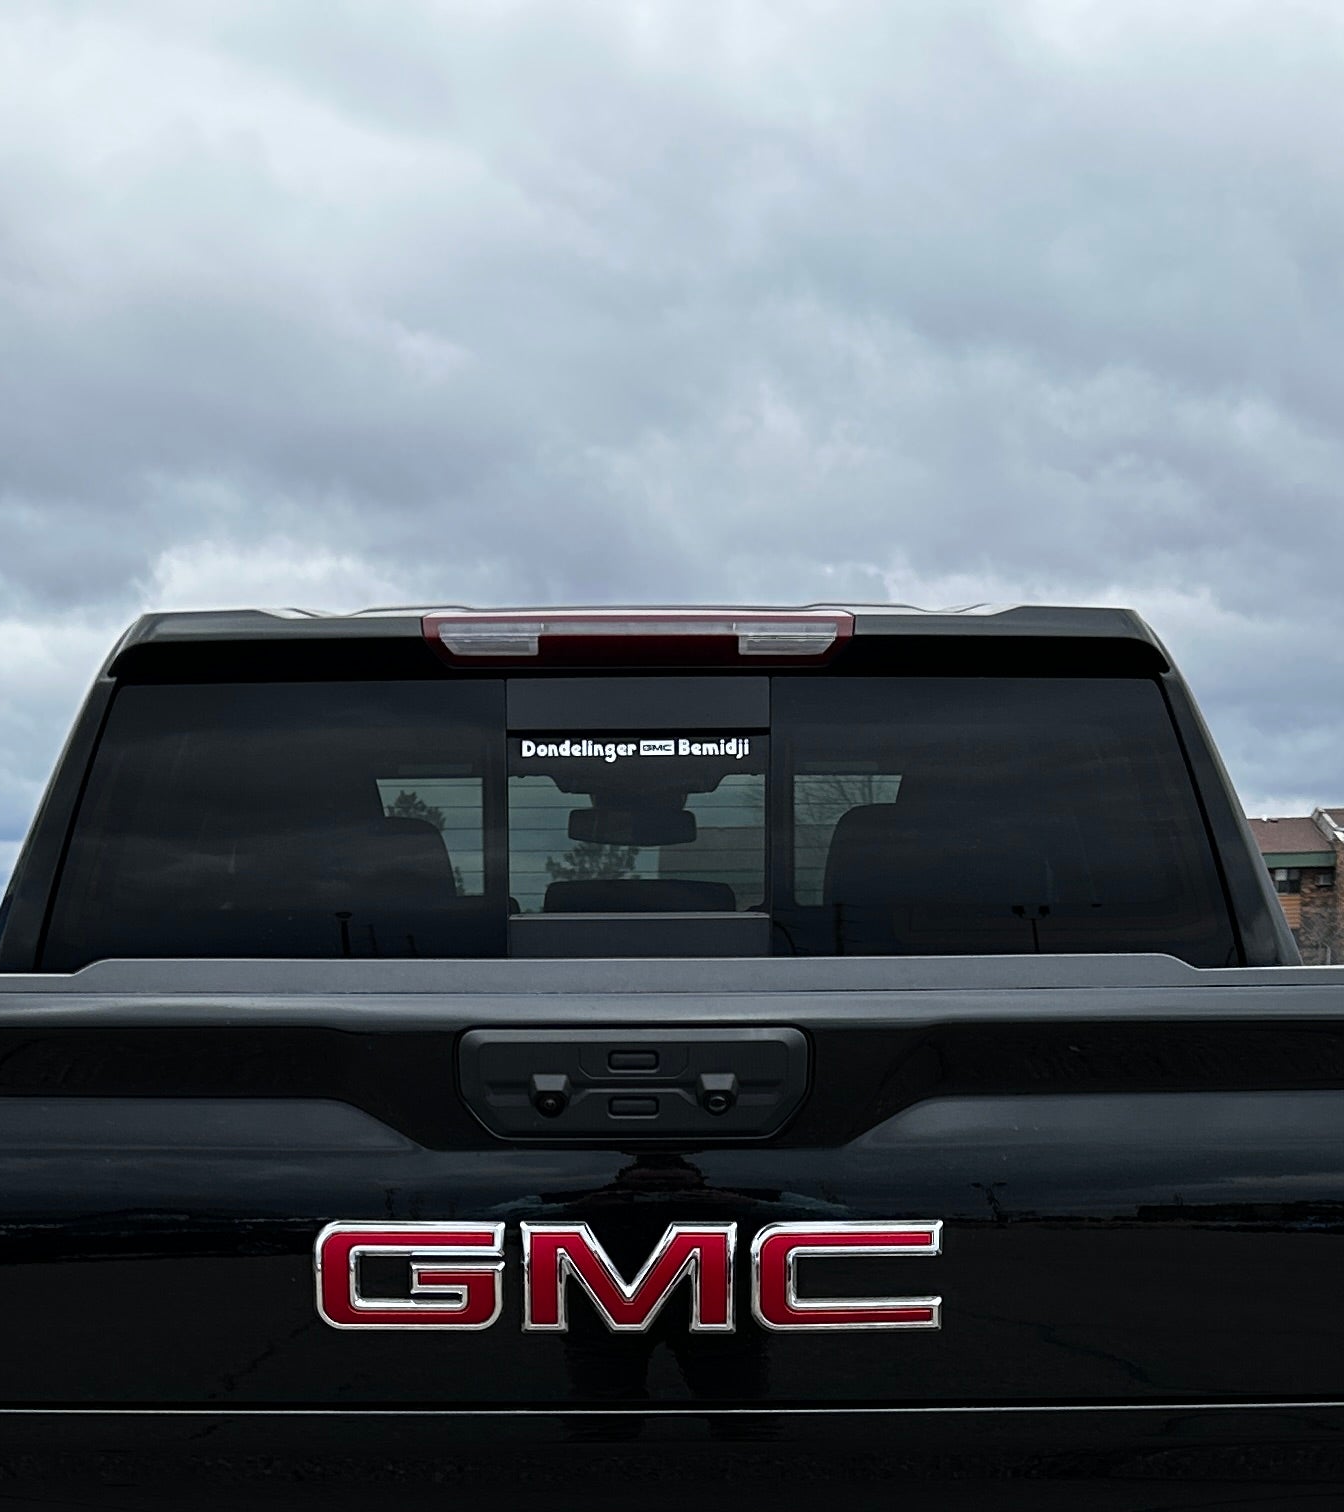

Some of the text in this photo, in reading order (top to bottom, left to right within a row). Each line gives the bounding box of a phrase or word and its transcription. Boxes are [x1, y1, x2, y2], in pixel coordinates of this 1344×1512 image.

[521, 738, 750, 762] Dondelinger GMC Bemidji
[314, 1221, 944, 1333] GMC
